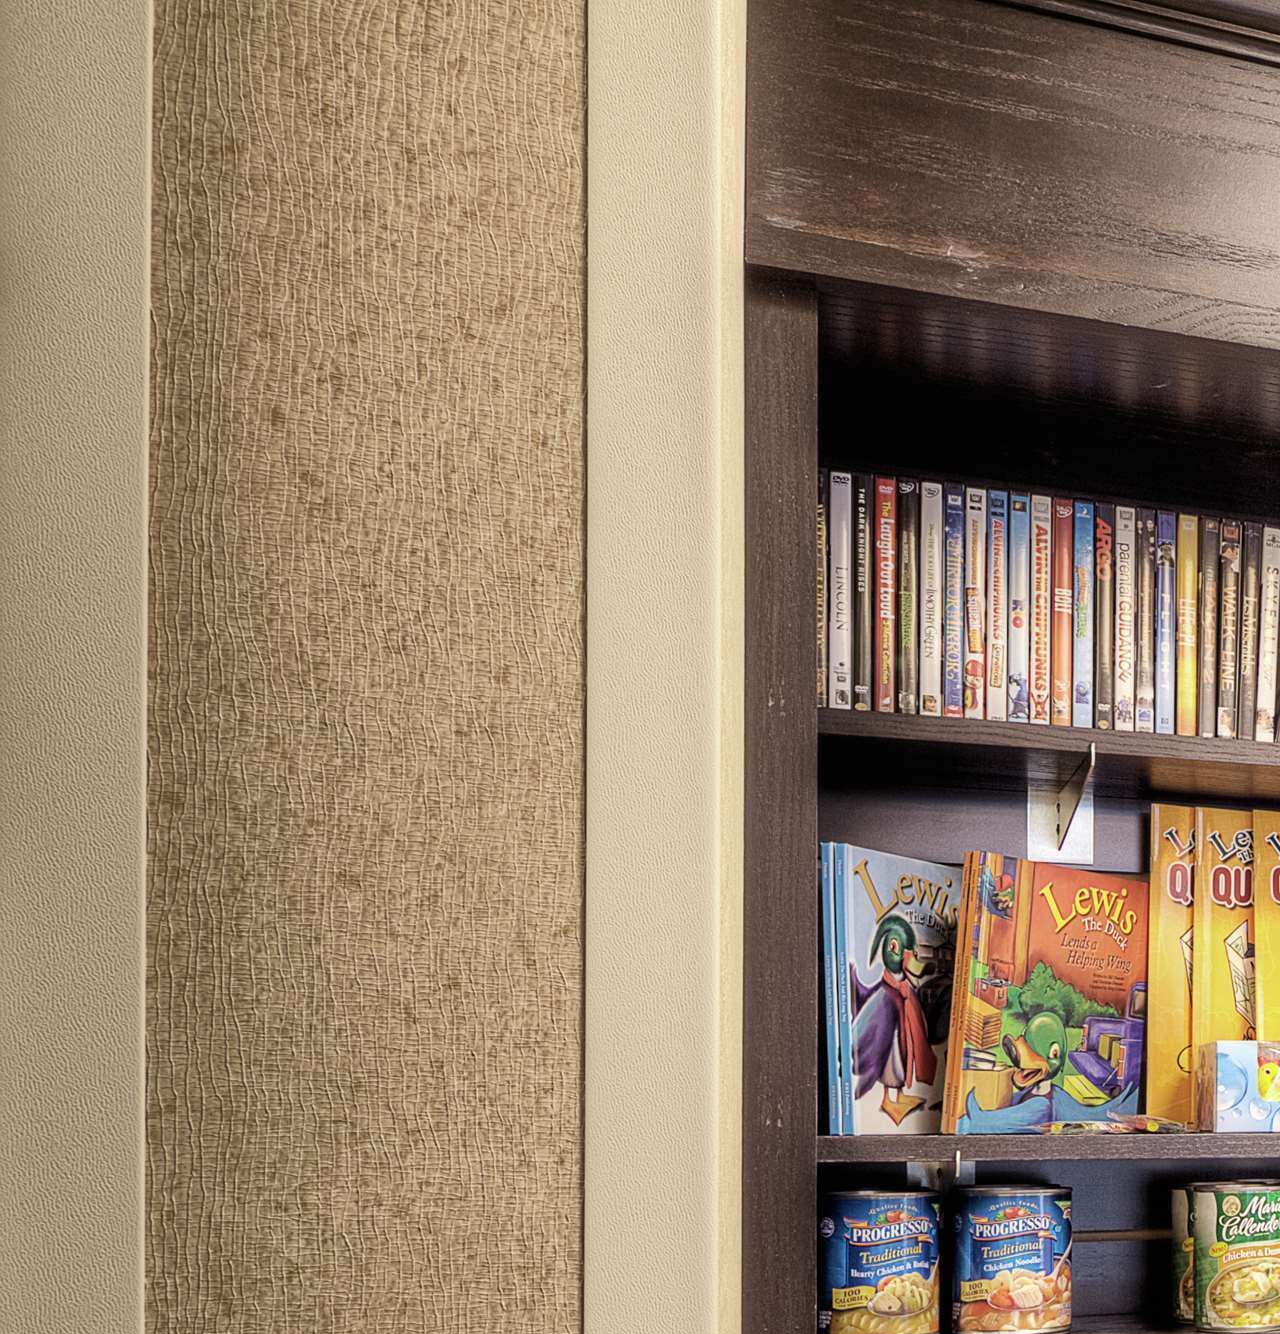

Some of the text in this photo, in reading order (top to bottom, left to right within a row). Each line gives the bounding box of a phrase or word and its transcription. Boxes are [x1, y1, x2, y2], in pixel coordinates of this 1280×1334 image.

[993, 520, 1003, 556] ALVIN
[1096, 519, 1111, 581] ARGO
[877, 502, 894, 619] The Laugh Out Loud
[835, 567, 848, 631] LINCOLN
[993, 571, 1002, 640] CHIPMUNKS
[1036, 525, 1048, 691] ALVIN CHIPMUNKS
[1055, 588, 1072, 614] BOLT
[1117, 543, 1132, 683] parental GUIDANCE
[924, 626, 936, 658] GREEN
[1161, 593, 1169, 691] FLIGHT
[1223, 586, 1236, 691] WALK LINE
[853, 859, 960, 928] Lewis
[1040, 882, 1138, 935] Lewis
[1061, 933, 1097, 950] Lends a
[1082, 916, 1128, 951] The Duck
[1066, 950, 1131, 973] Helping Wing
[853, 1220, 928, 1243] PROGRESSO
[975, 1216, 1050, 1237] PROGRESSO
[860, 1243, 922, 1264] Traditional
[982, 1240, 1044, 1259] Traditional
[983, 1256, 1042, 1272] Chicken Noodle
[1223, 1248, 1255, 1263] Chicken
[851, 1264, 904, 1279] Hearty Chicken
[968, 1282, 983, 1290] 100
[842, 1289, 861, 1297] 100
